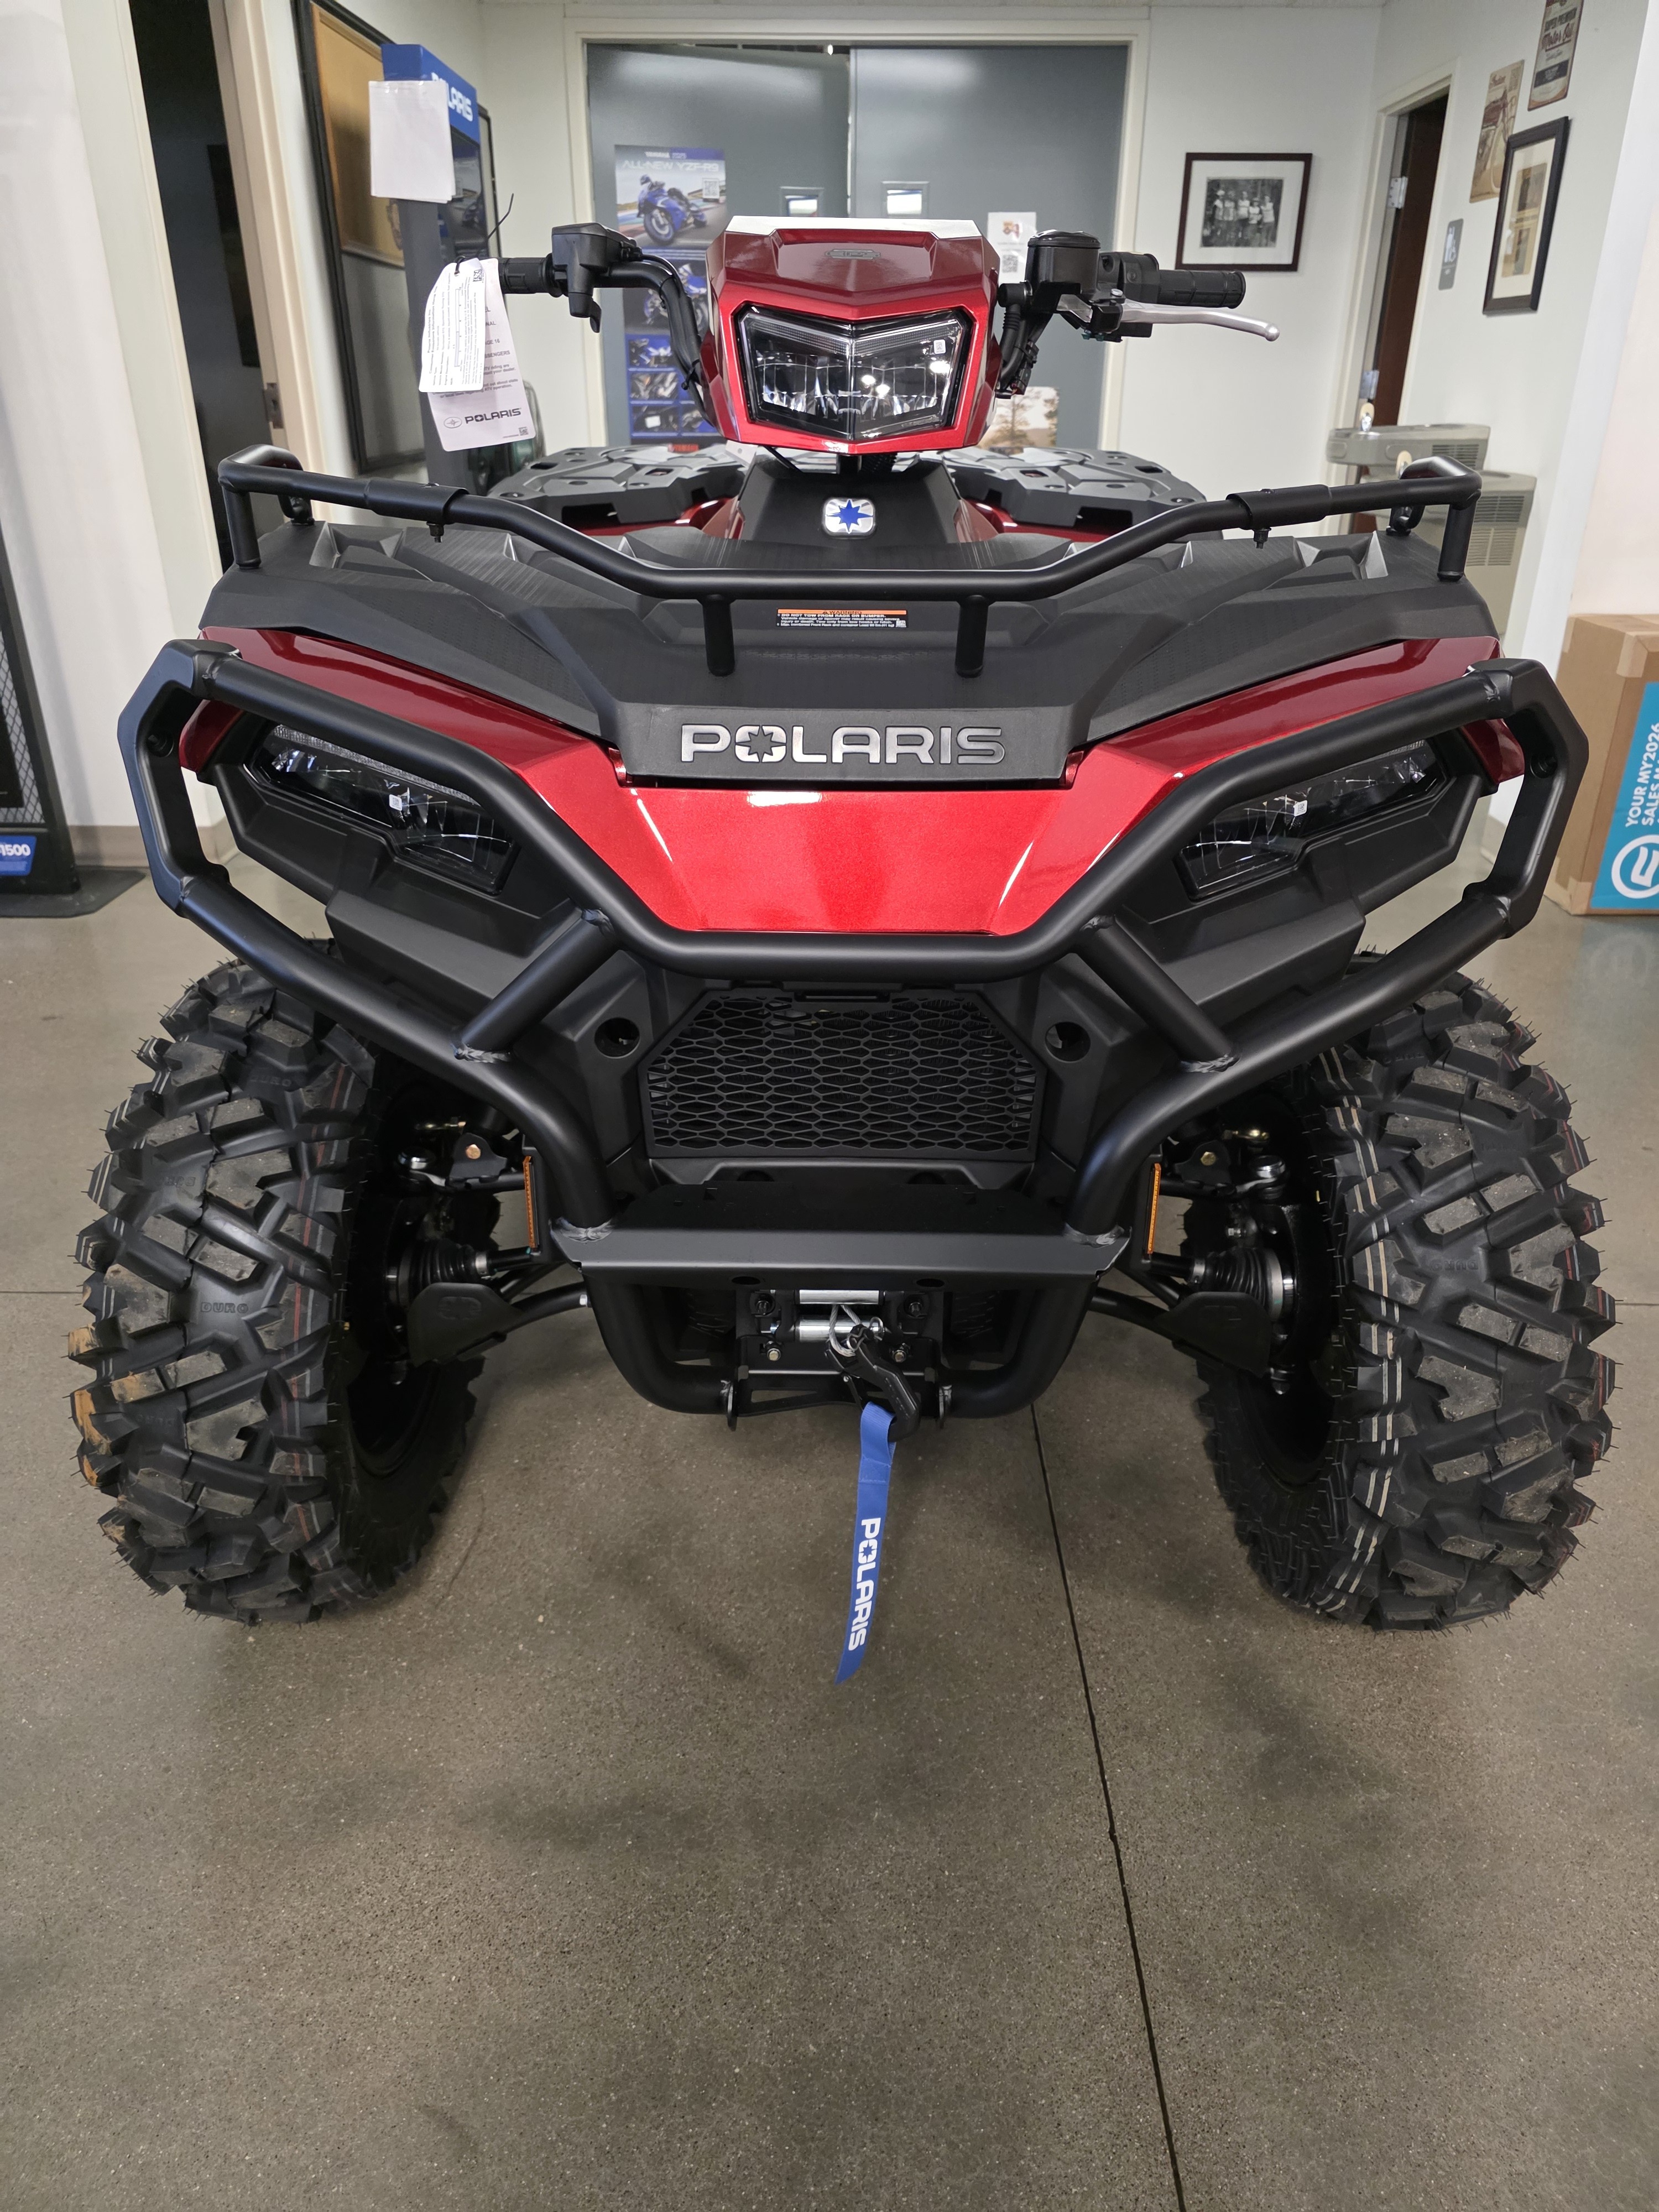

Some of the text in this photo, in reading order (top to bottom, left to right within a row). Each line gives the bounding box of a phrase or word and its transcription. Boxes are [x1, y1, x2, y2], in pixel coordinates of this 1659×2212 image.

[622, 160, 674, 170] ALL-NEW
[485, 350, 510, 359] SSENGERS
[465, 408, 521, 424] POLARIS
[681, 724, 1005, 765] POLARIS
[1625, 722, 1659, 828] YOUR MY2026
[1641, 782, 1659, 826] SALES
[0, 844, 31, 856] 1500
[200, 1301, 249, 1314] DURO
[848, 1517, 881, 1651] POLARIS
